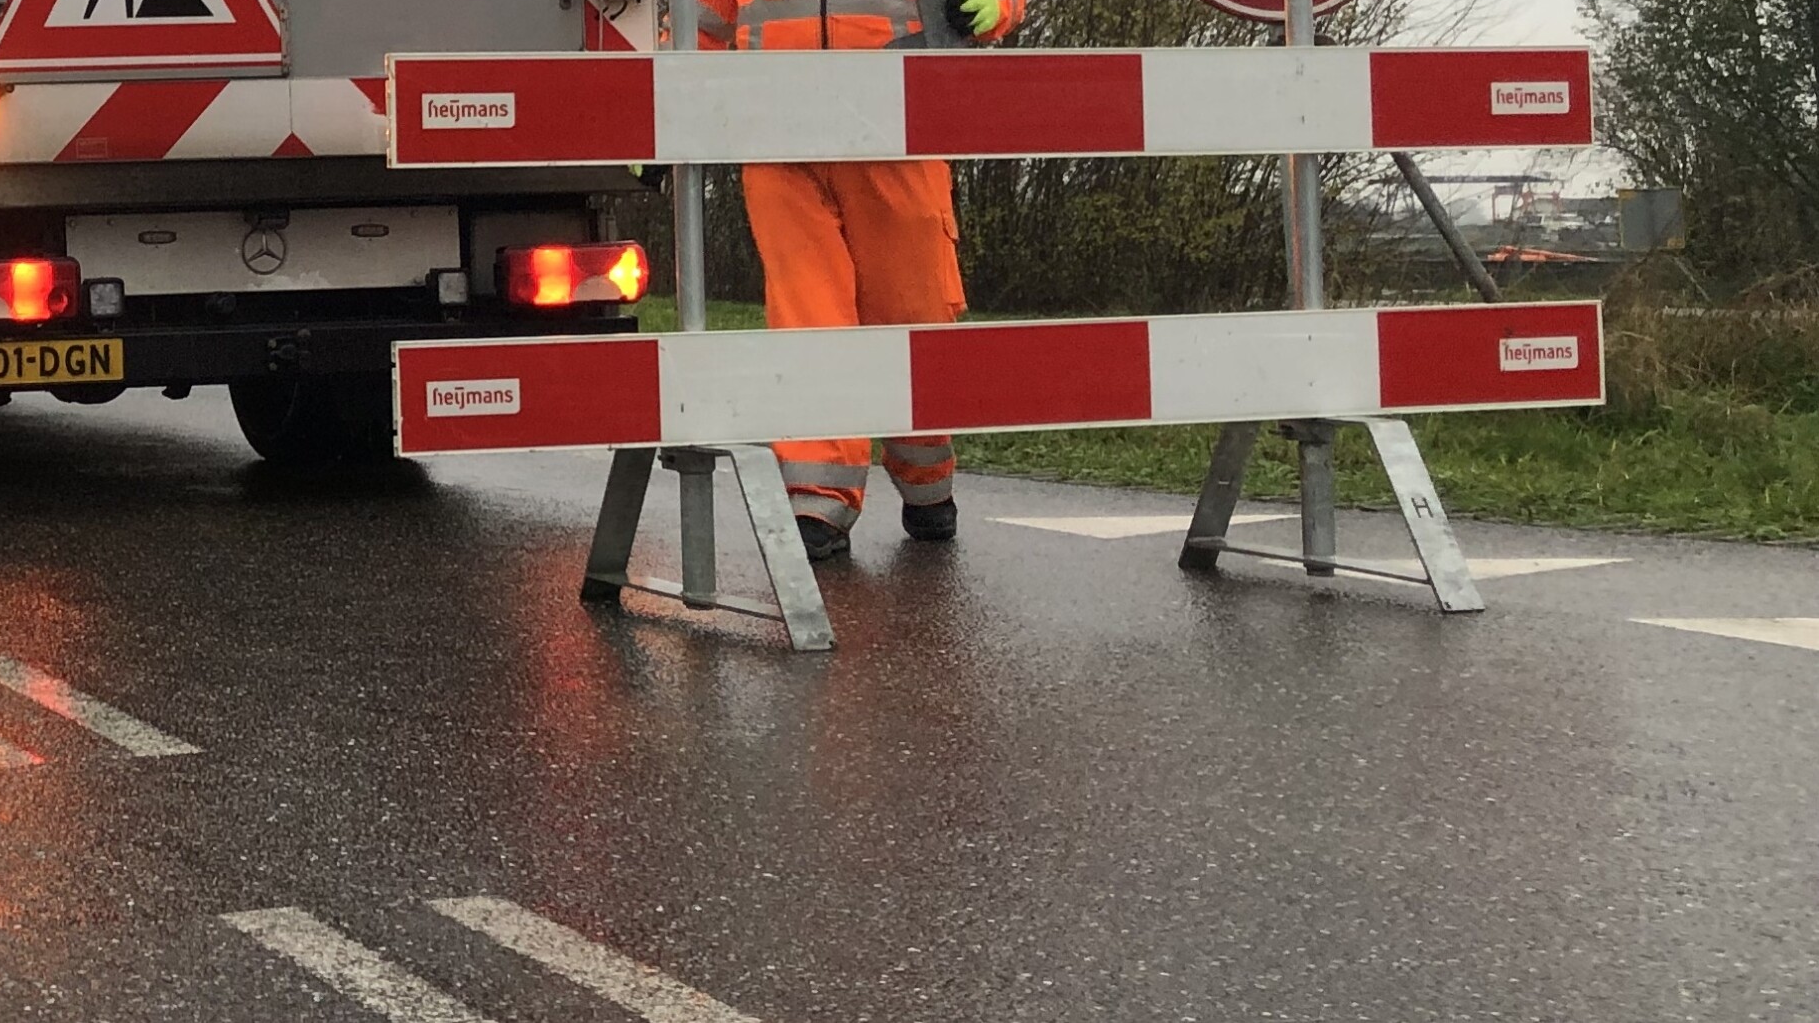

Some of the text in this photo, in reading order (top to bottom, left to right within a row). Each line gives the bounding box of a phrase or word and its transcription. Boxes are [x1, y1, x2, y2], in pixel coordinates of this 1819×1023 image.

[1496, 88, 1564, 108] heijmans
[428, 99, 509, 122] heijmans
[1504, 344, 1573, 365] heijmans
[433, 387, 514, 409] heijmans
[1411, 497, 1433, 518] H
